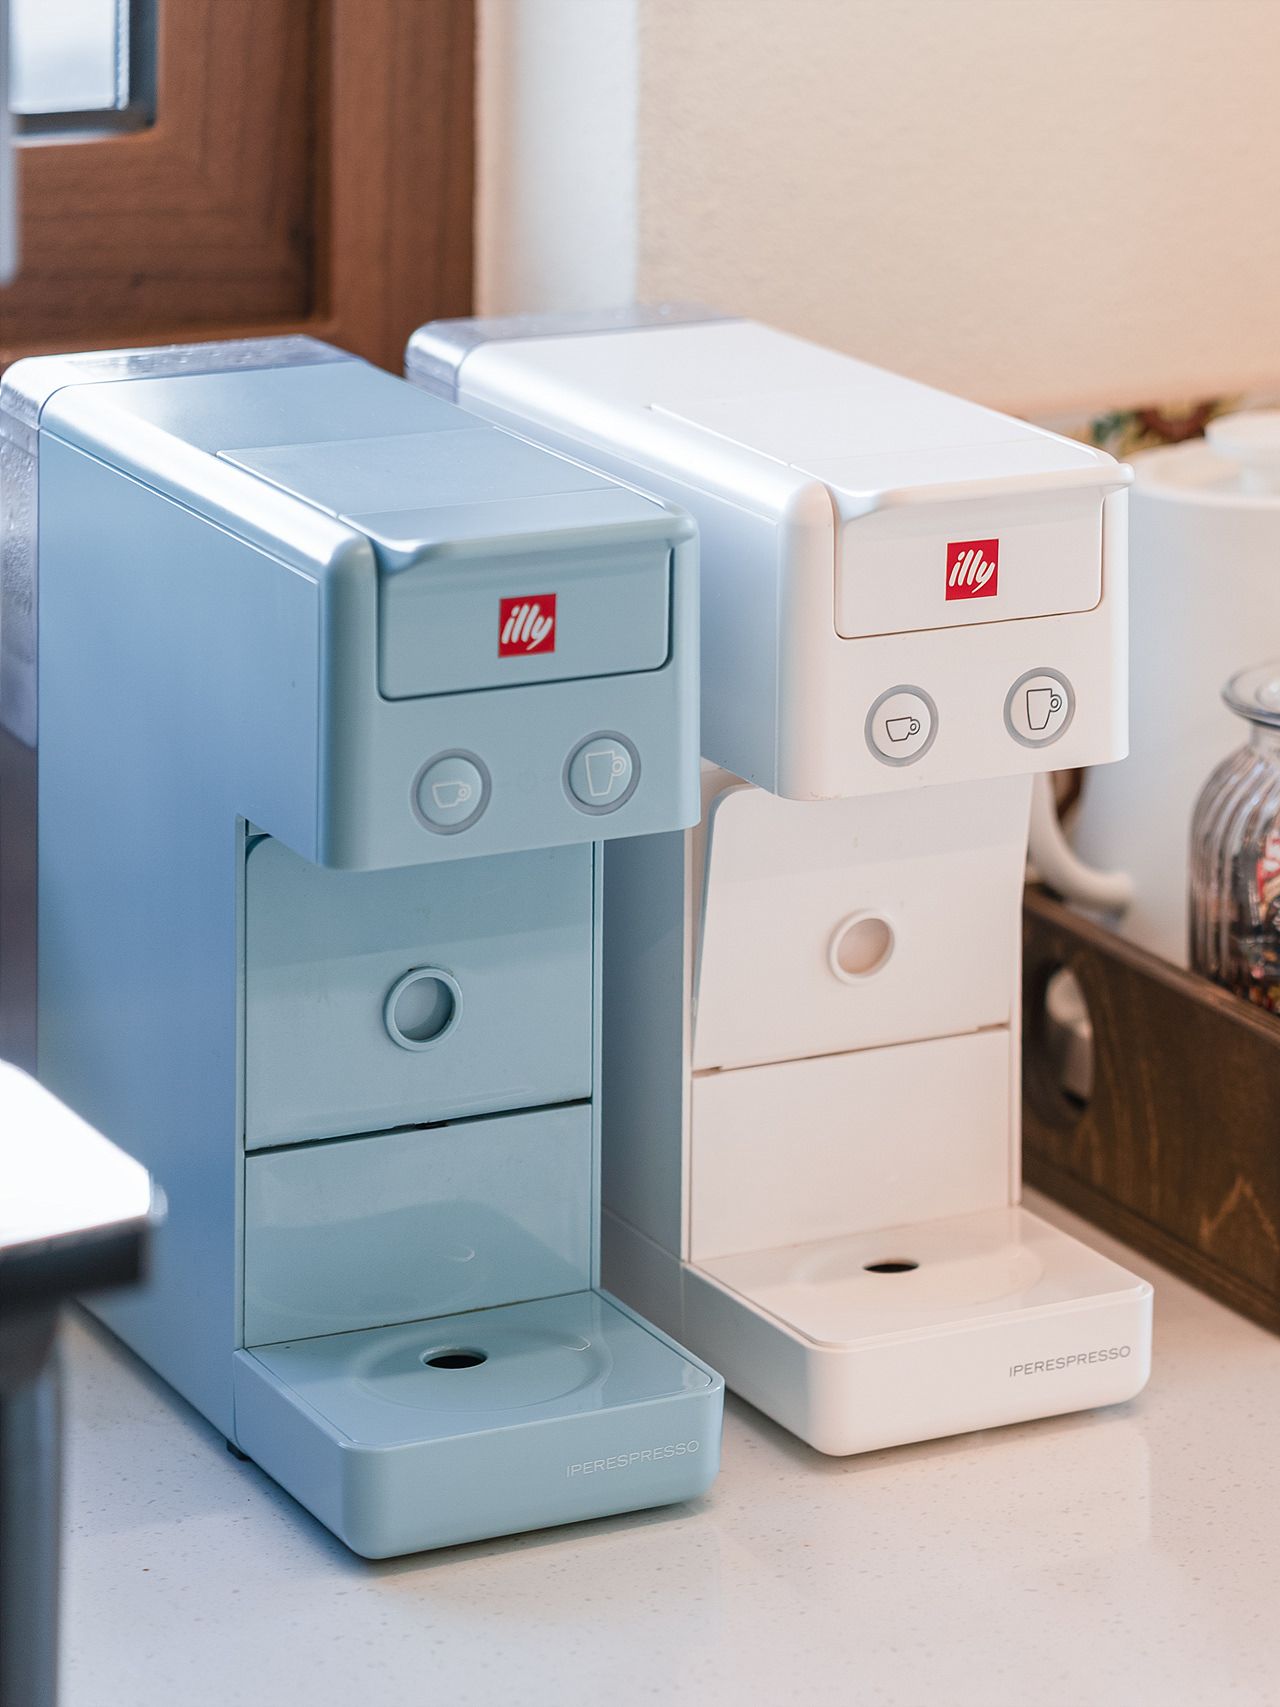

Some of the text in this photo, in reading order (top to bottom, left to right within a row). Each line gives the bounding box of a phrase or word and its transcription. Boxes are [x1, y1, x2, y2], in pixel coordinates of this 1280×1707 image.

[949, 549, 996, 594] illy
[501, 603, 553, 651] illy
[1008, 1344, 1132, 1378] IPERESPRESSO
[565, 1439, 701, 1479] IPERESPRESSO
